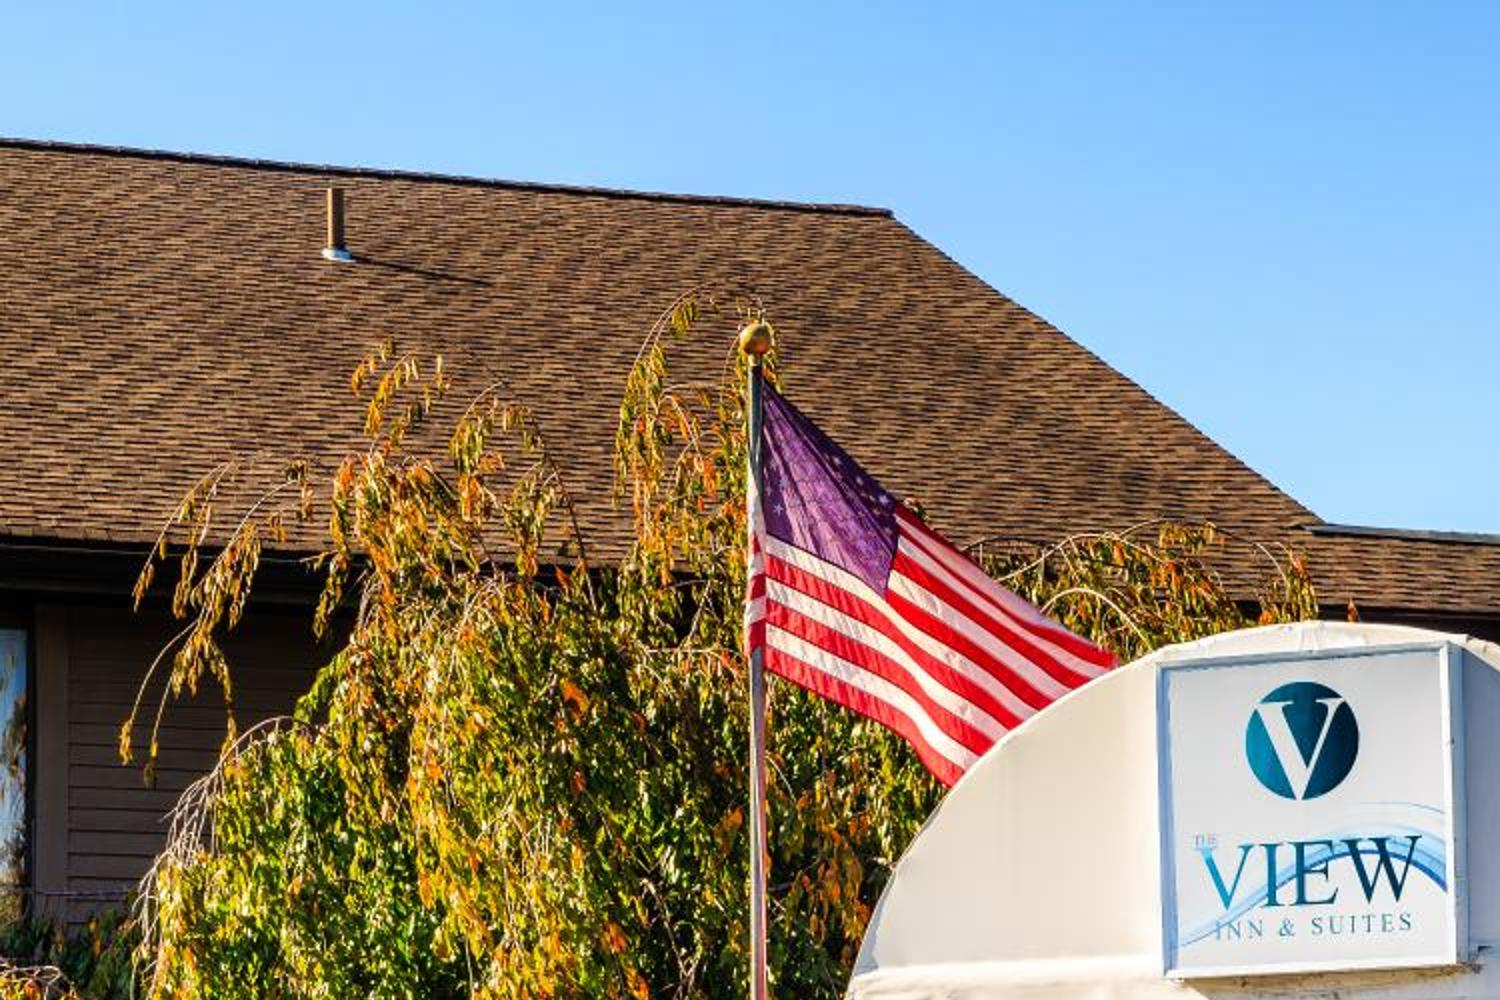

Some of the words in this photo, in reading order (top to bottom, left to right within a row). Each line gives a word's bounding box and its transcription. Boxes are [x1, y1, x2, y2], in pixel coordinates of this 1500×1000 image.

[1255, 697, 1346, 800] V
[1198, 834, 1422, 911] VIEW
[1215, 919, 1264, 940] INN
[1279, 918, 1296, 937] &
[1311, 913, 1413, 935] SUITES
